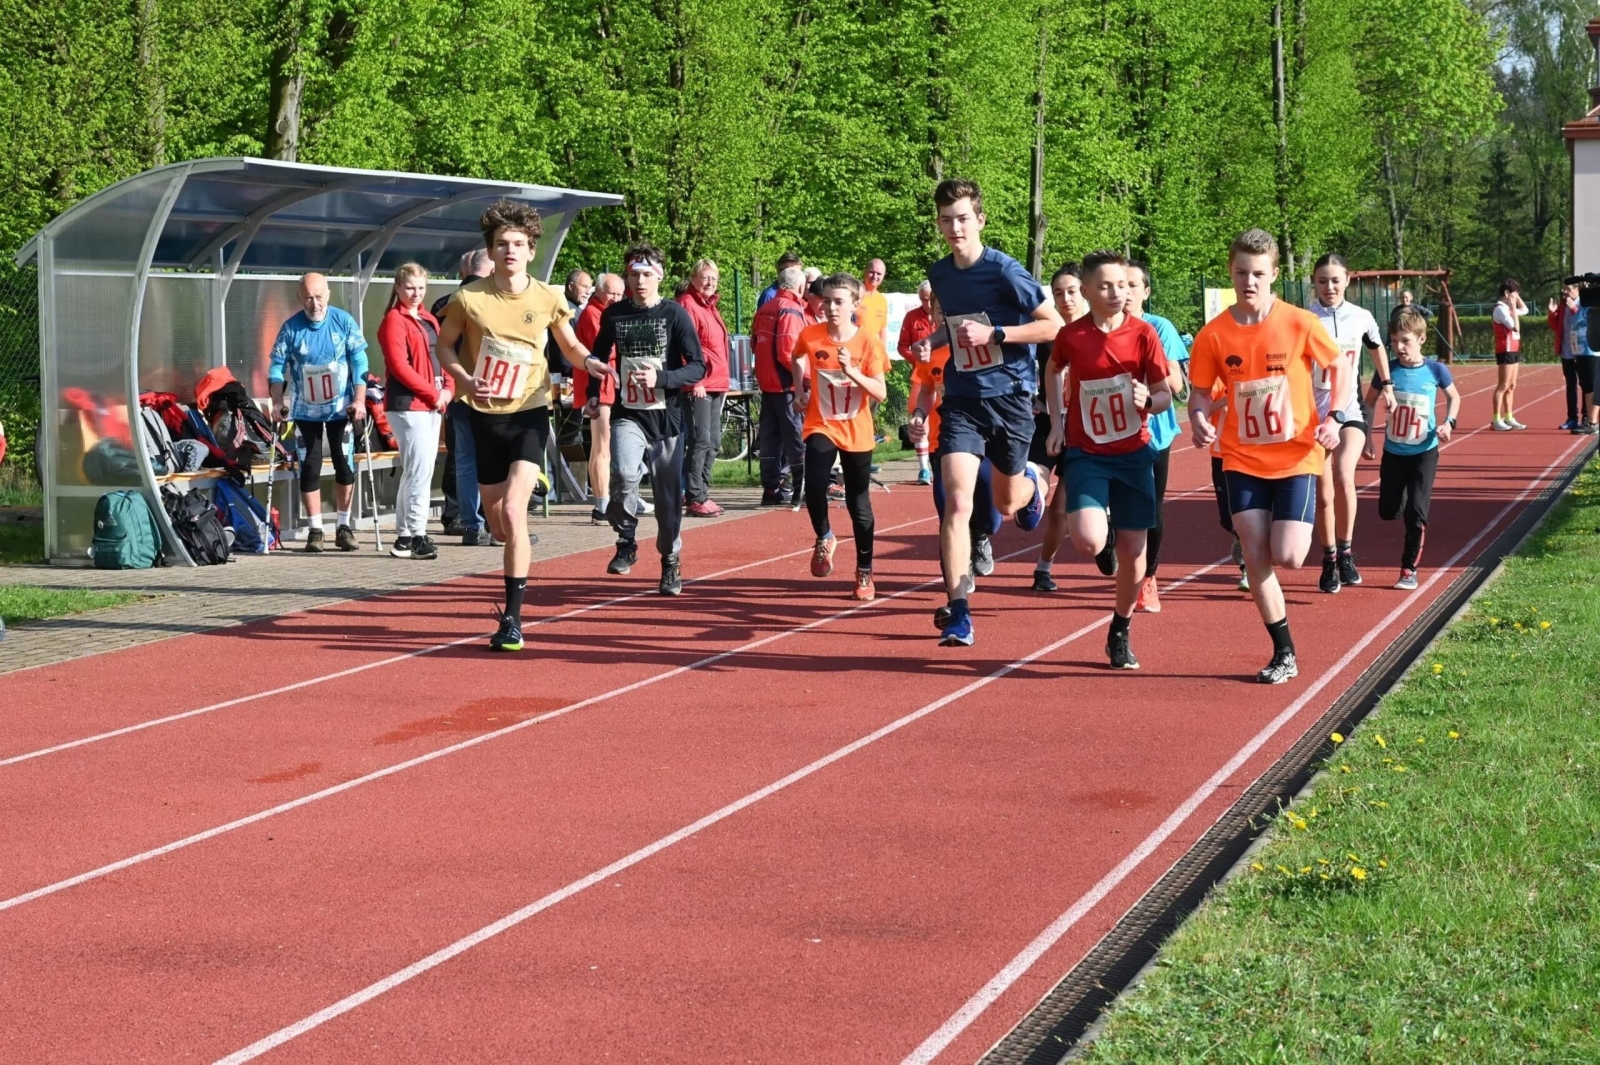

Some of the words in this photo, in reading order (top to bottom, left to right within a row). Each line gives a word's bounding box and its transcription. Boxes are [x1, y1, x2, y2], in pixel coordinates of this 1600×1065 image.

[307, 373, 334, 402] 10
[482, 356, 521, 400] 181
[827, 381, 852, 415] 17
[1090, 392, 1128, 436] 68
[1244, 393, 1282, 438] 66
[1391, 405, 1421, 438] 104
